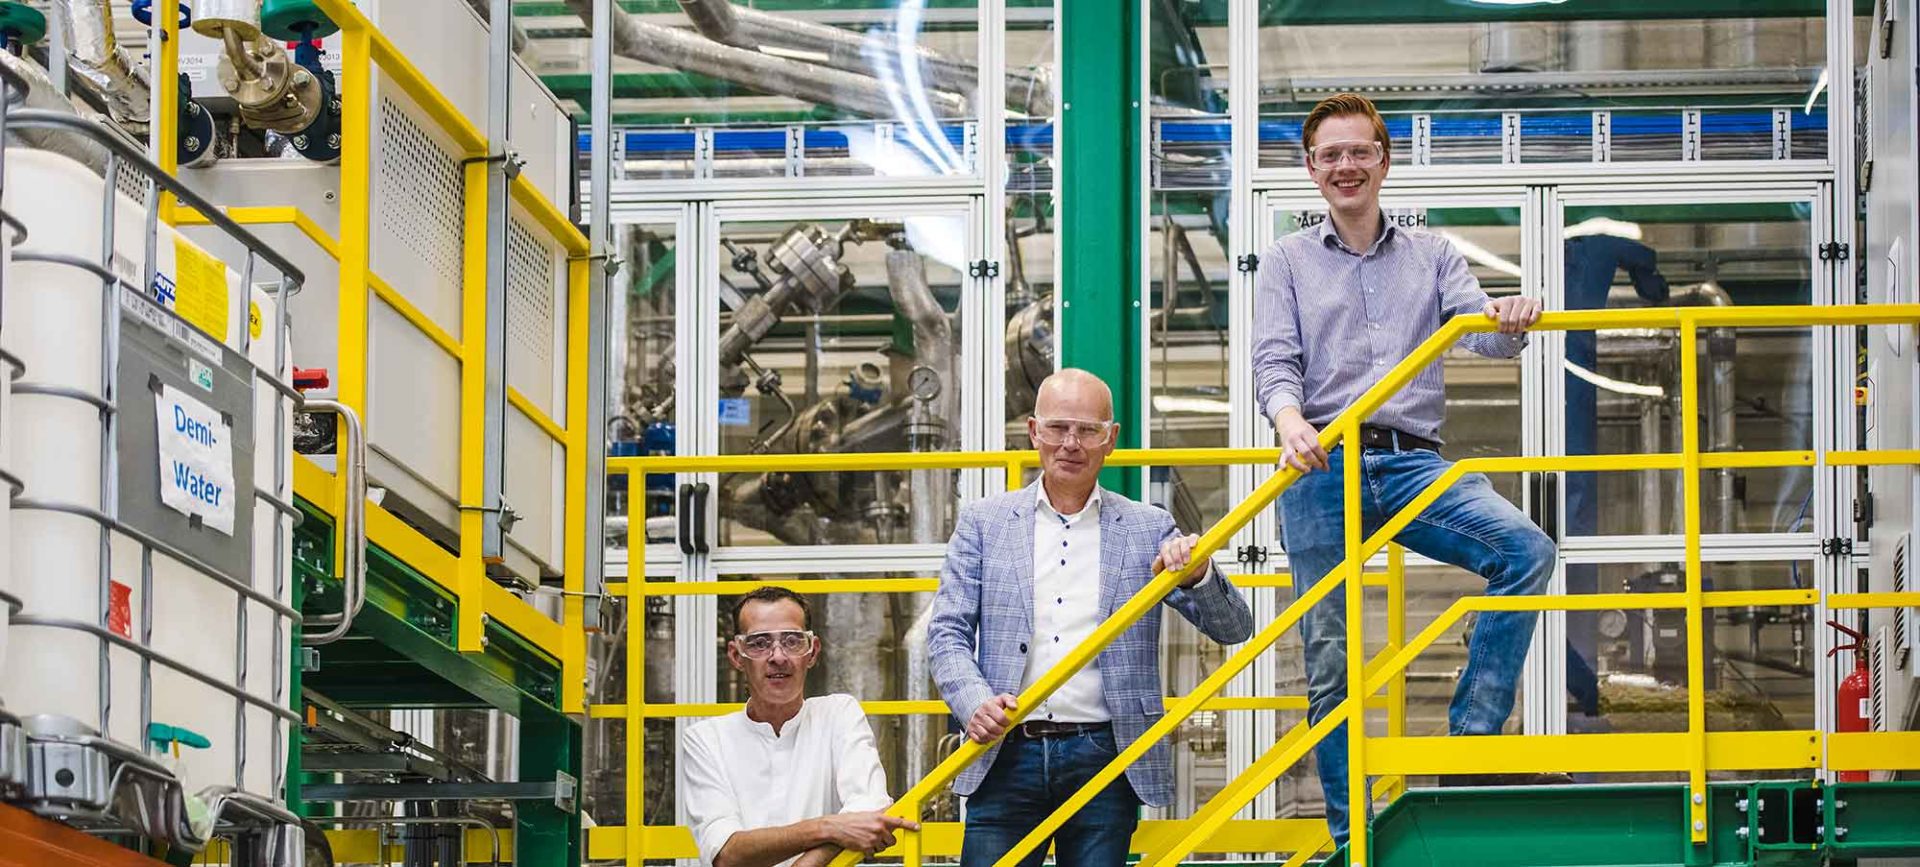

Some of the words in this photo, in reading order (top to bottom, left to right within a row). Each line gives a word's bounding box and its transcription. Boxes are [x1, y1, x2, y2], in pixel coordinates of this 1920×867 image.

[1388, 214, 1426, 227] TECH
[173, 403, 217, 449] Demi-
[173, 460, 222, 506] Water
